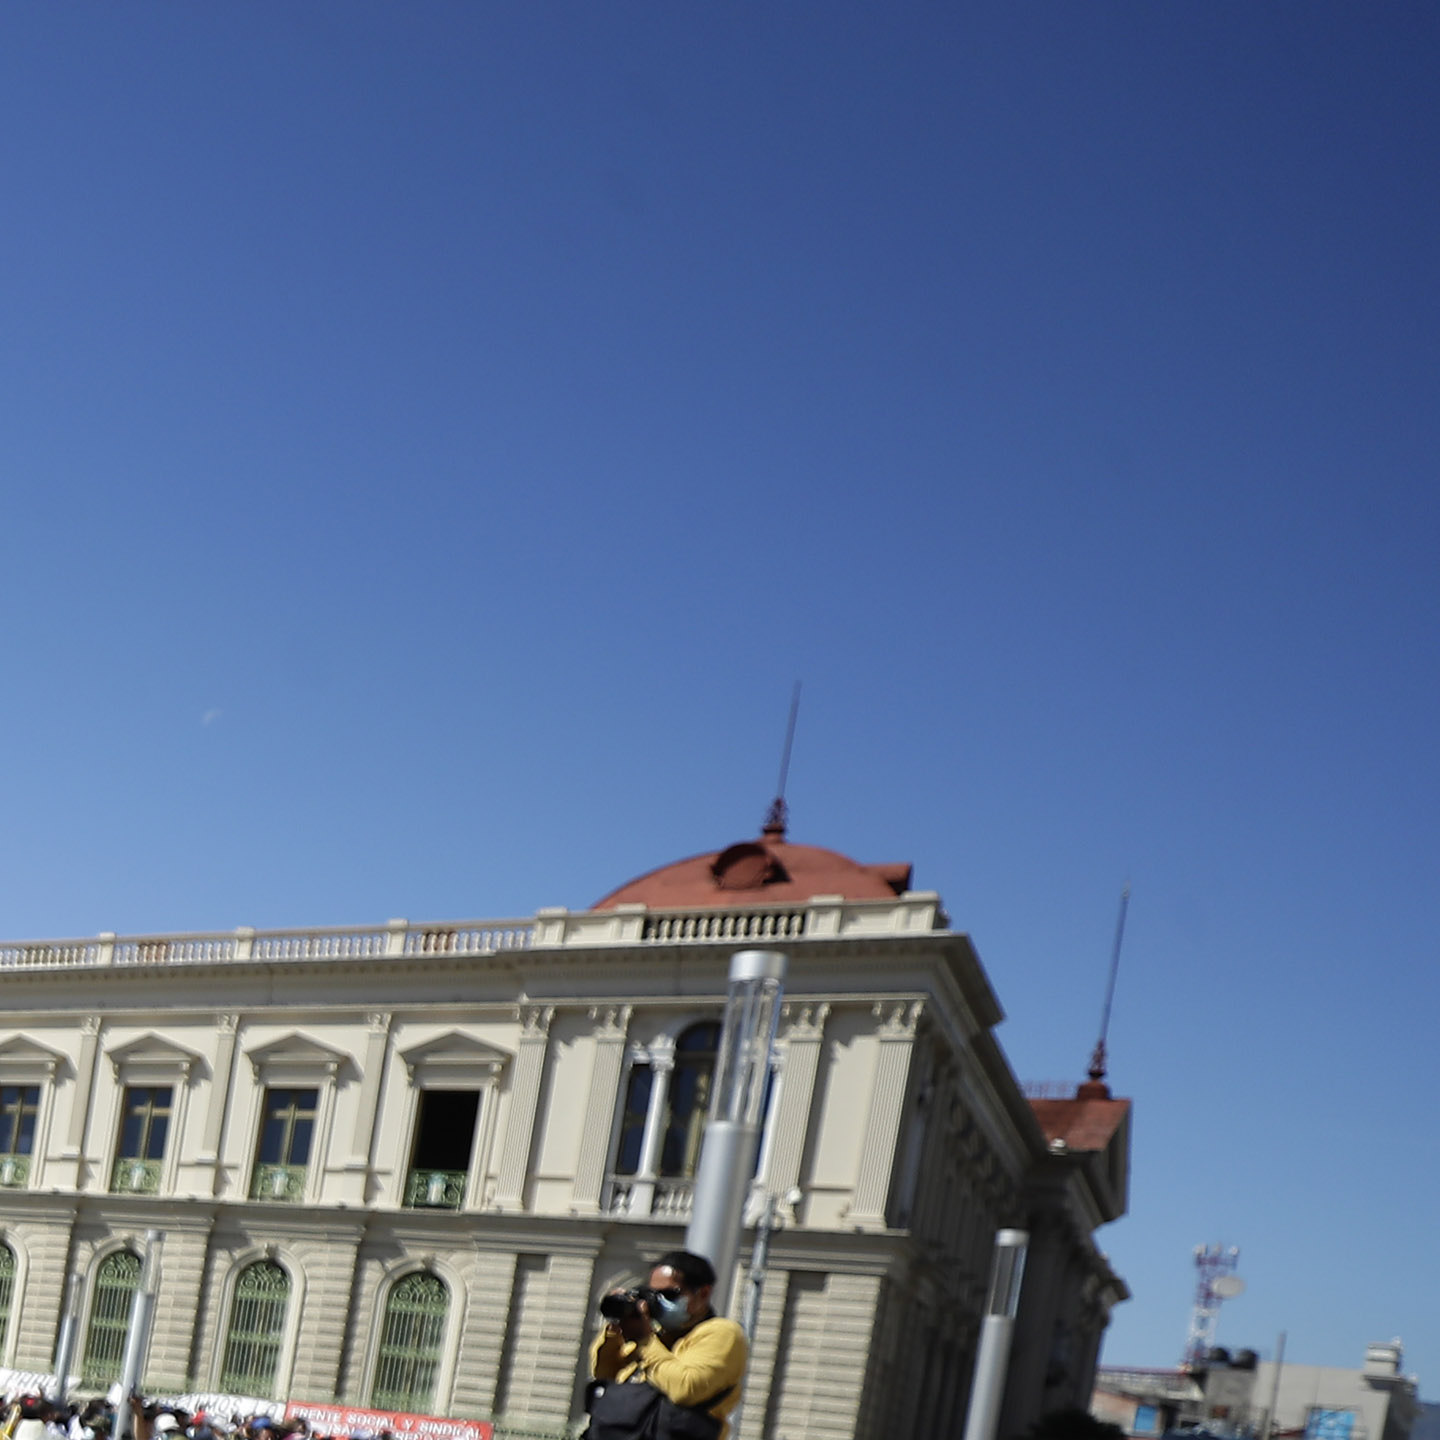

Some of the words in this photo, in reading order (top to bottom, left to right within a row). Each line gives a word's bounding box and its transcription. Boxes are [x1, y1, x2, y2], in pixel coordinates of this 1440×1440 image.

[291, 1406, 342, 1423] FRENTE
[347, 1411, 396, 1429] SOCIAL
[404, 1416, 415, 1431] Y
[420, 1419, 483, 1440] SINDICAL
